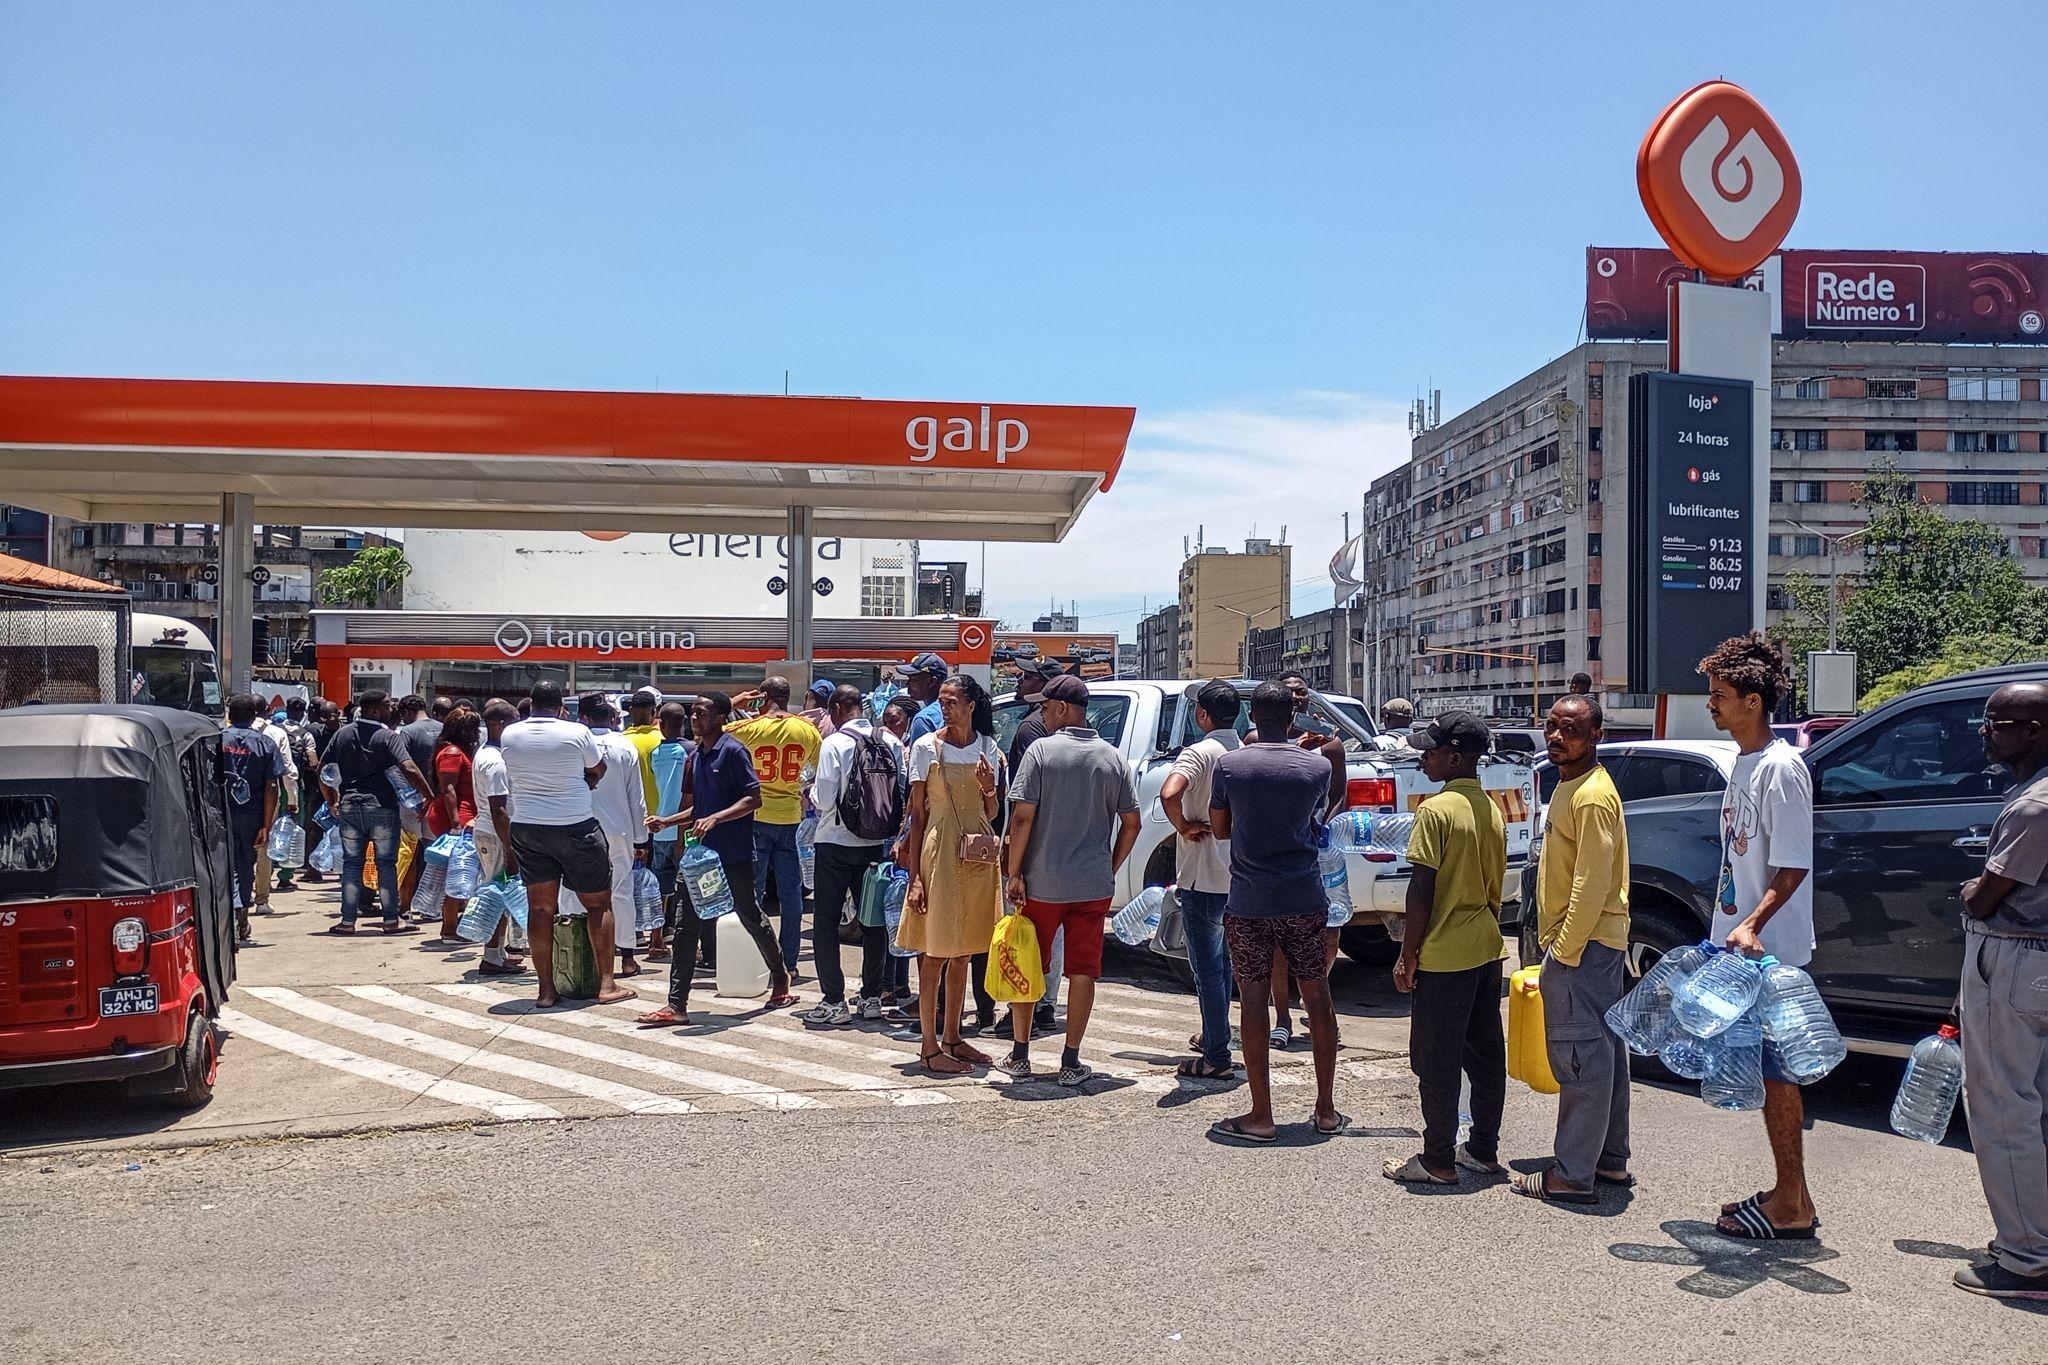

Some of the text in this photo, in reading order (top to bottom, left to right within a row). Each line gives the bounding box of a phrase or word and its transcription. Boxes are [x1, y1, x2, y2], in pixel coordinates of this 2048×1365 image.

[1817, 272, 1896, 301] Rede
[1816, 300, 1915, 322] Número 1
[2025, 317, 2037, 325] 5G
[1688, 394, 1712, 412] loja
[905, 406, 1029, 464] galp
[1678, 431, 1729, 446] 24 horas
[1702, 469, 1720, 483] gás
[1668, 502, 1740, 519] lubrificantes
[1709, 538, 1742, 553] 91.23
[1709, 557, 1742, 572] 86.25
[204, 570, 217, 580] 01
[253, 571, 268, 581] 02
[768, 581, 783, 590] 03
[817, 582, 832, 591] 04
[1709, 576, 1742, 591] 09.47
[546, 625, 695, 655] tangerina
[754, 744, 806, 784] 36
[115, 989, 143, 1001] AMJ
[104, 1000, 154, 1014] 326 MC
